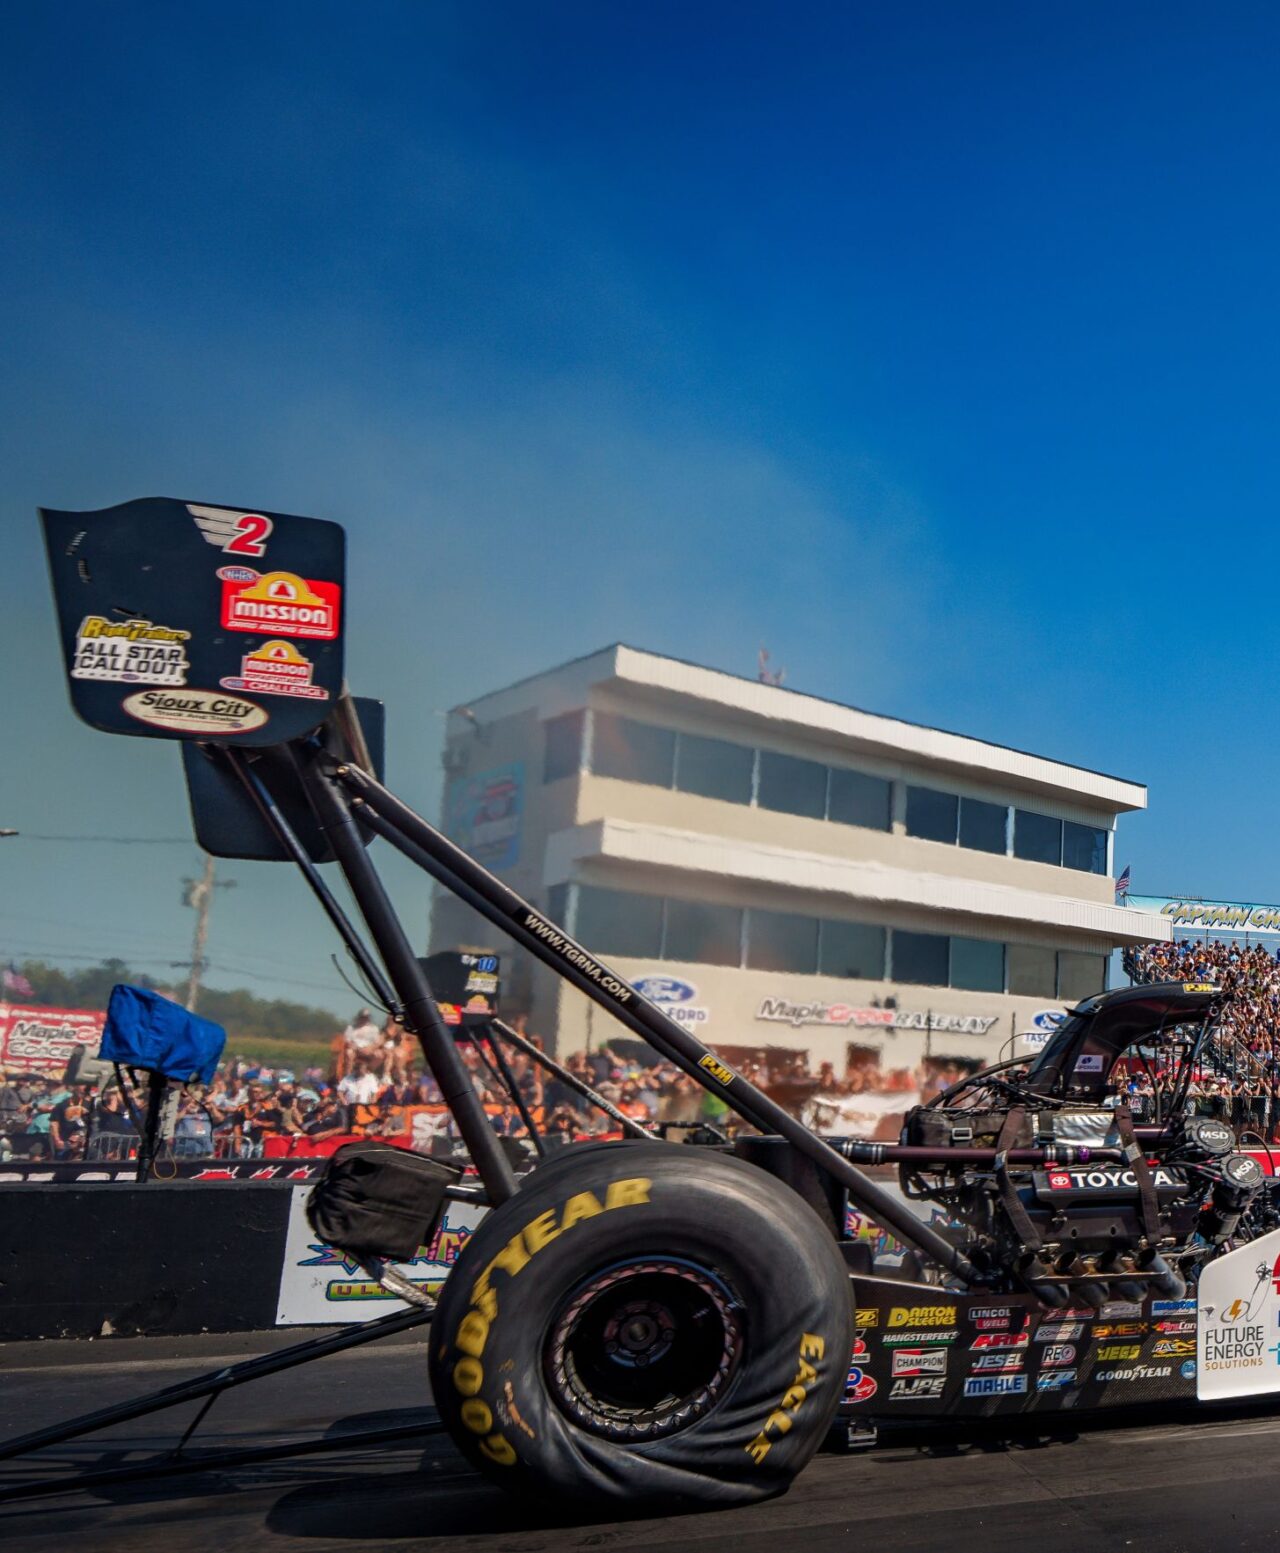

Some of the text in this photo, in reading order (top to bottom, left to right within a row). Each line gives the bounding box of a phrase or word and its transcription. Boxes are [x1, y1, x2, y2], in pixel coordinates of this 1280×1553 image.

[223, 513, 273, 557] 2
[81, 642, 181, 661] ALL STAR
[80, 656, 181, 675] CALLOUT
[140, 692, 255, 715] Sioux City
[1160, 902, 1253, 928] CAPTAIN
[525, 914, 631, 1002] WWW.TGRNA.COM
[1025, 1034, 1050, 1044] TASC
[1200, 1130, 1229, 1141] MSD
[1071, 1170, 1173, 1188] TOYOA
[1233, 1160, 1256, 1180] MSD
[453, 1177, 652, 1466] GOODYEAR
[888, 1306, 957, 1327] DARTON
[906, 1317, 956, 1327] SLEEVES
[971, 1309, 1011, 1319] LINCOL
[983, 1320, 1010, 1328] WELD
[882, 1331, 960, 1343] HANGSTERFER'S
[1205, 1326, 1264, 1345] FUTURE
[972, 1353, 1024, 1368] JESEL
[1205, 1342, 1264, 1361] ENERGY
[897, 1357, 944, 1368] CHAMPION
[1205, 1358, 1263, 1371] SOLUTIONS
[1096, 1364, 1172, 1381] GOODYEAR
[967, 1377, 1022, 1393] MAHLE
[744, 1332, 825, 1465] EAGLE
